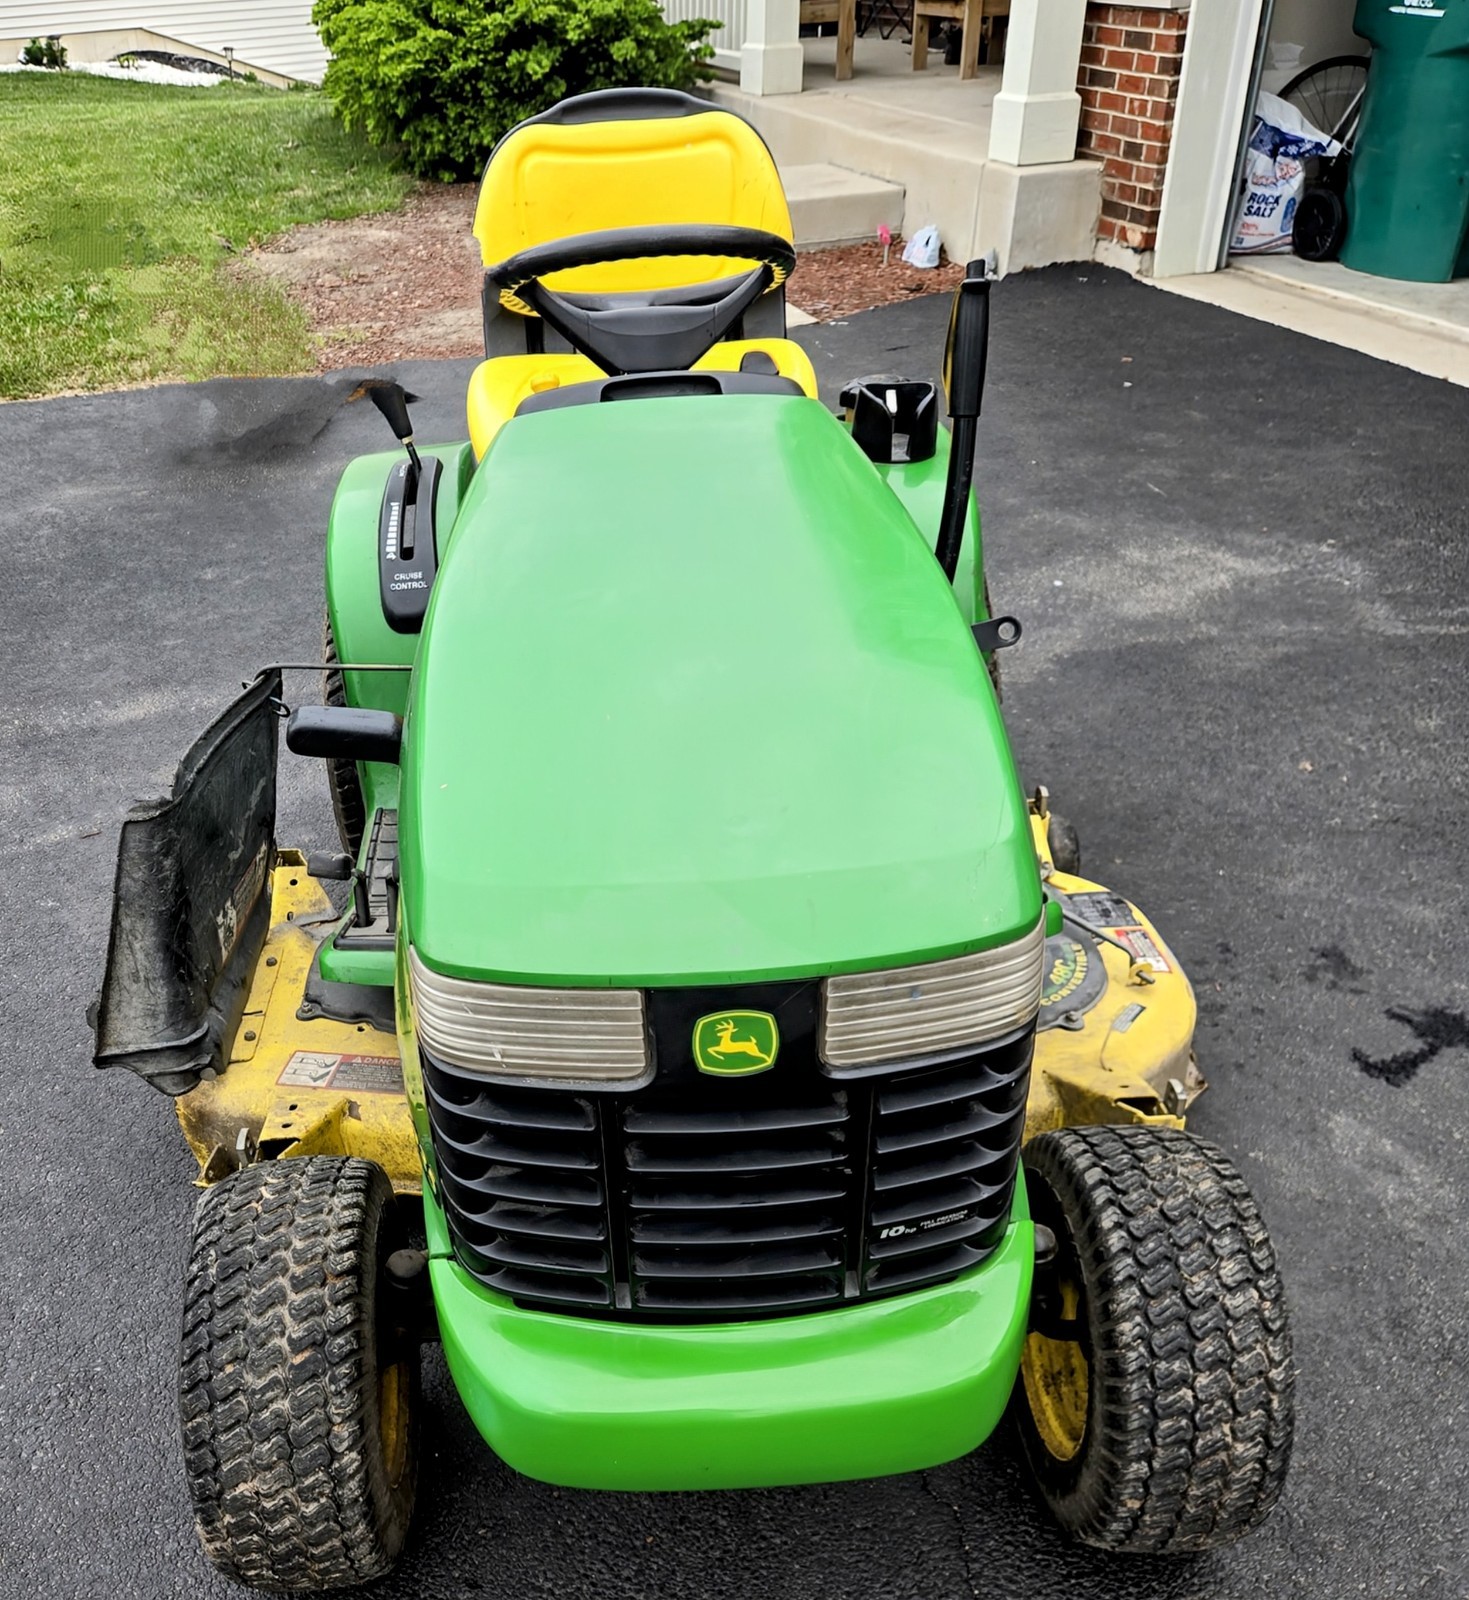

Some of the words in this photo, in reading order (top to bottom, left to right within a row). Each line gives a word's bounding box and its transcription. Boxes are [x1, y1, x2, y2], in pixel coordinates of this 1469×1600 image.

[1247, 192, 1282, 206] ROCK
[1243, 204, 1276, 218] SALT
[393, 571, 423, 581] CRUISE
[390, 580, 429, 591] CONTROL
[363, 1056, 402, 1066] DANGE
